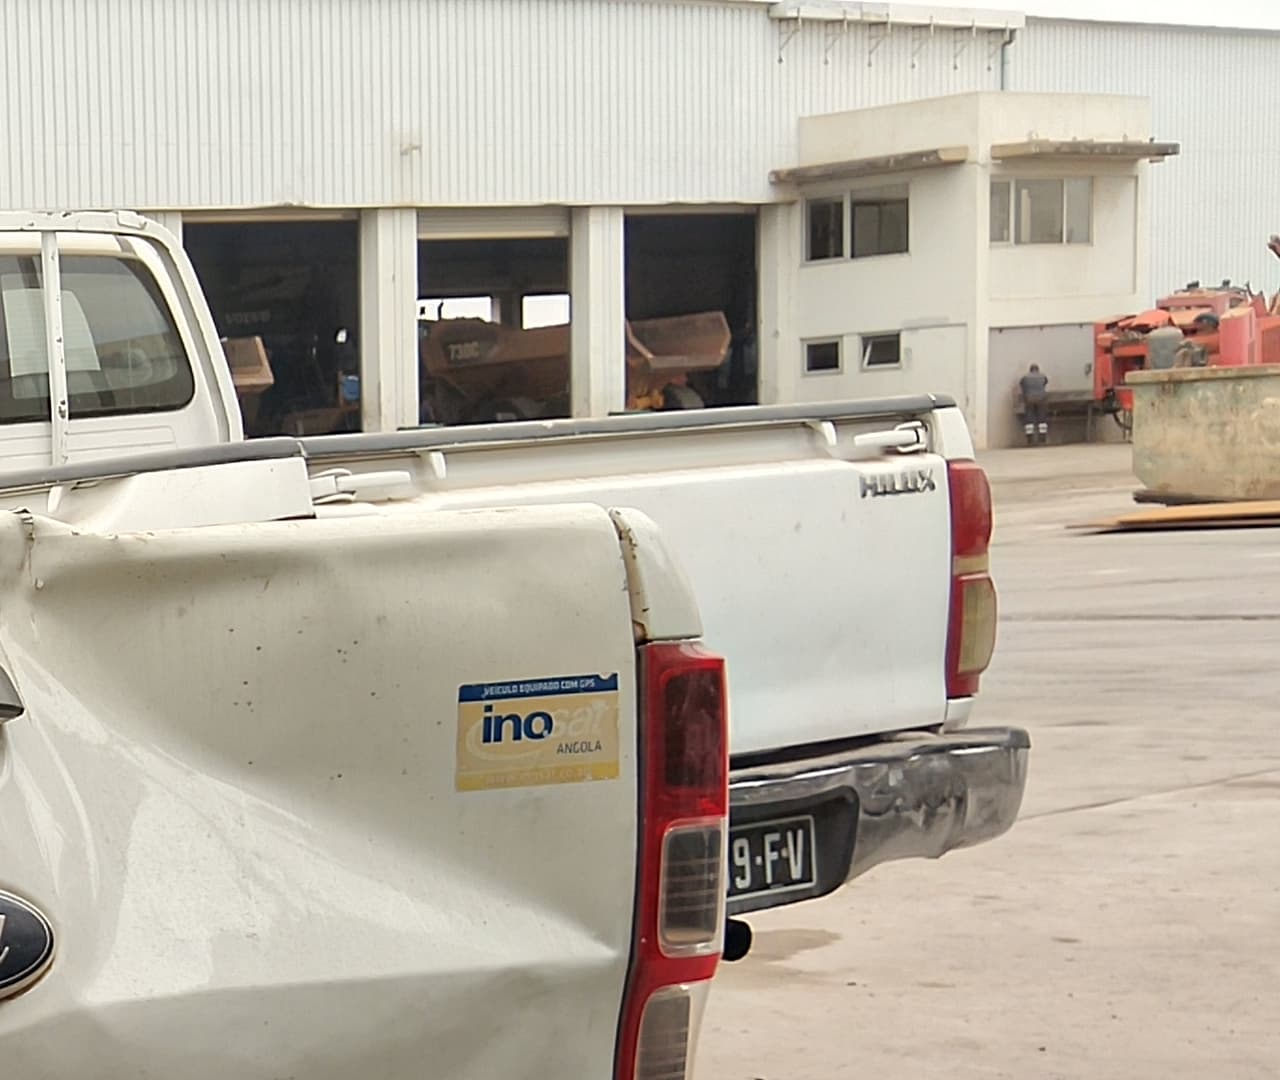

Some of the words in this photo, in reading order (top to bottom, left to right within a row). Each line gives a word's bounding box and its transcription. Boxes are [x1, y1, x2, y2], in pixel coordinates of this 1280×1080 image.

[859, 468, 936, 498] HILUX
[580, 678, 596, 689] GPS
[556, 740, 602, 754] ANGOLA
